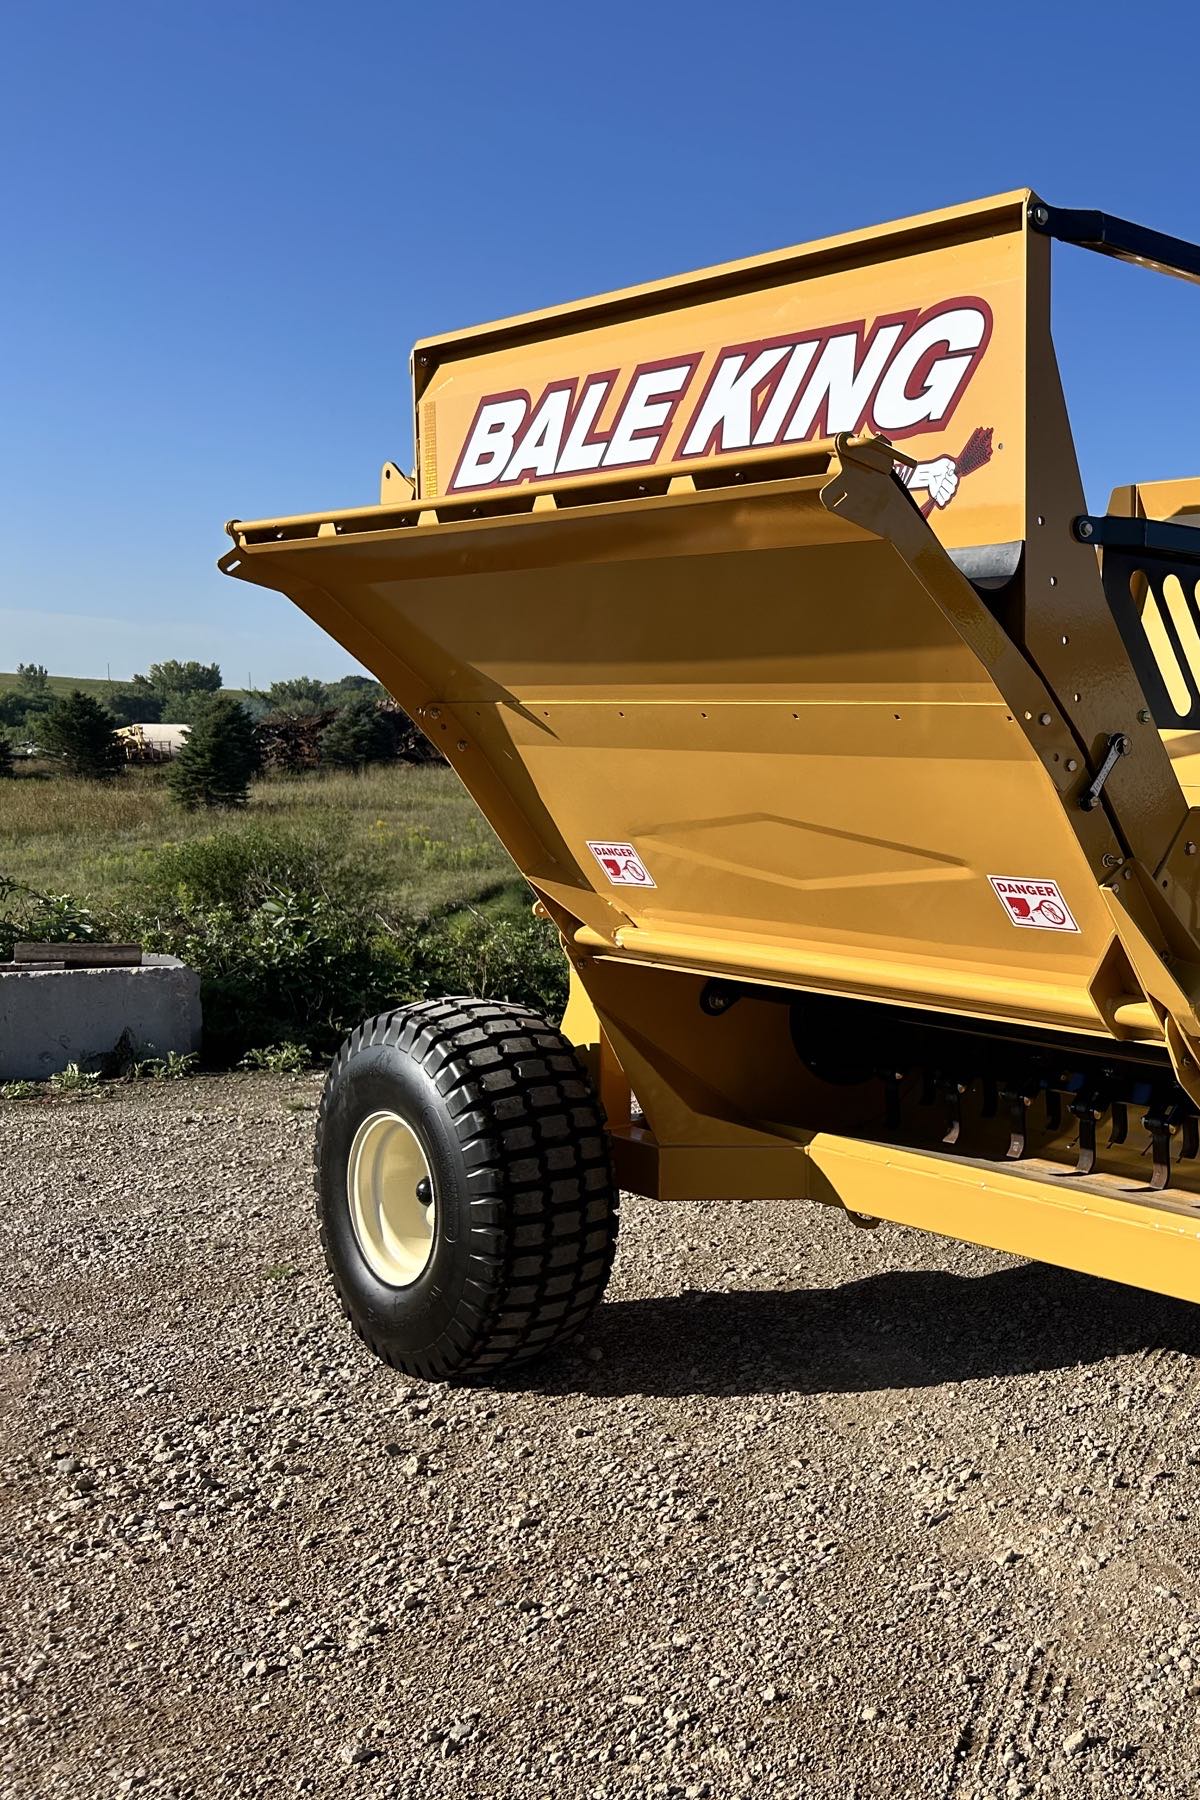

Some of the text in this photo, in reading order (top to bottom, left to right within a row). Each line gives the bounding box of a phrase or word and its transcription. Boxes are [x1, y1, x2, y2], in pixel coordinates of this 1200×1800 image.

[451, 307, 986, 490] BALE KING
[594, 847, 635, 857] DANGER
[996, 883, 1057, 897] DANGER
